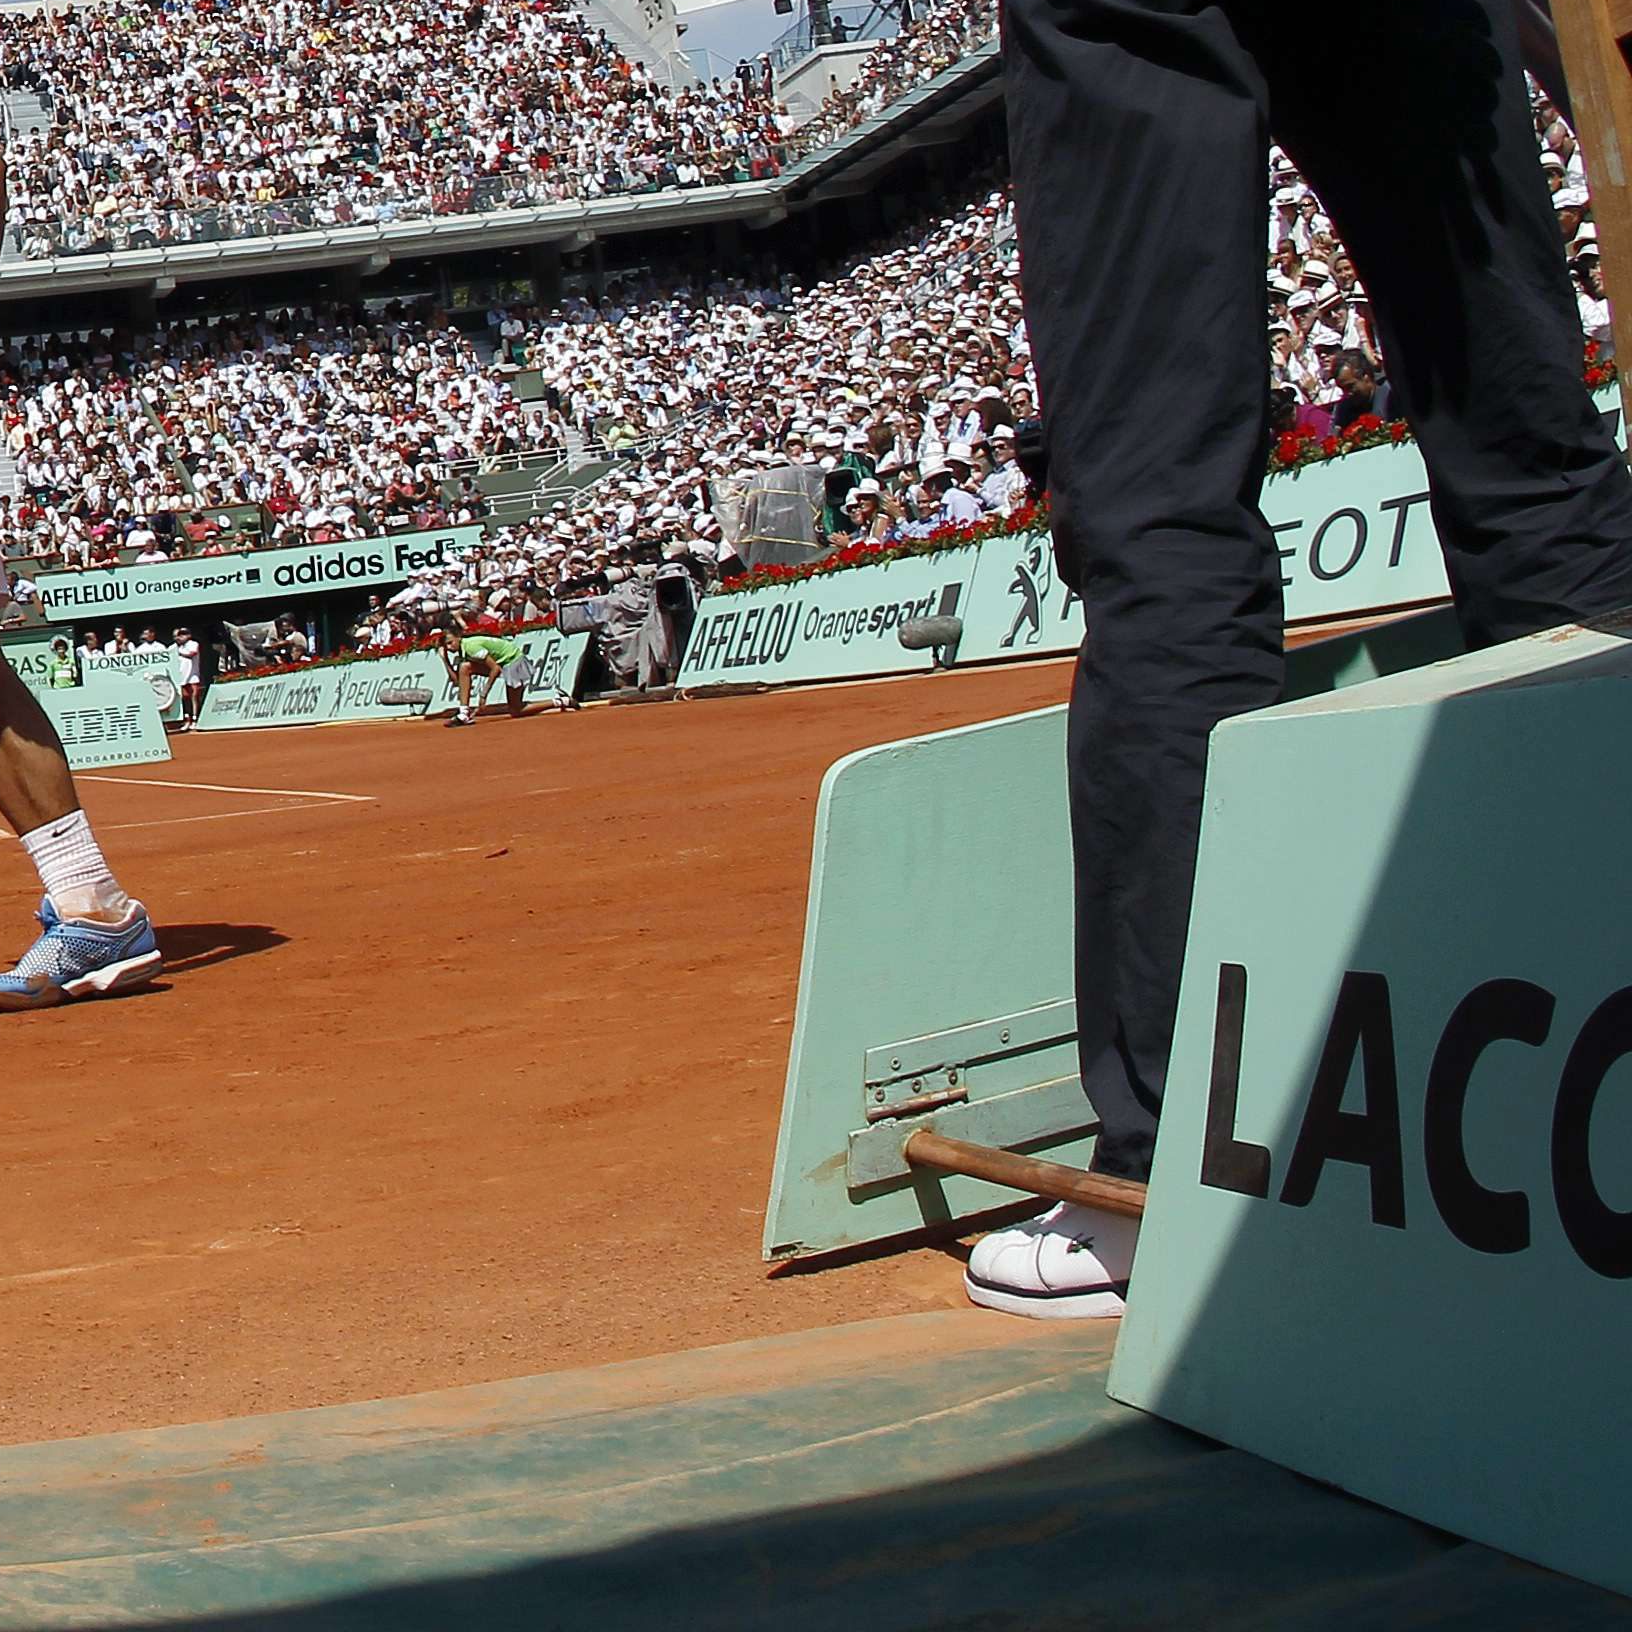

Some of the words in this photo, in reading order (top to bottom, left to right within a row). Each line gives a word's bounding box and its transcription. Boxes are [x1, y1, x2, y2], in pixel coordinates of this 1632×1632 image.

[41, 581, 128, 608] AFFLELOU
[135, 577, 190, 594] Orange
[192, 570, 243, 590] sport
[274, 551, 385, 587] adidas
[683, 600, 804, 673] AFFLELOU
[803, 606, 869, 645] Orange
[867, 589, 938, 639] sport
[89, 650, 171, 670] LONGINES
[60, 704, 143, 745] IBM
[69, 748, 169, 765] ANDGARROS.COM
